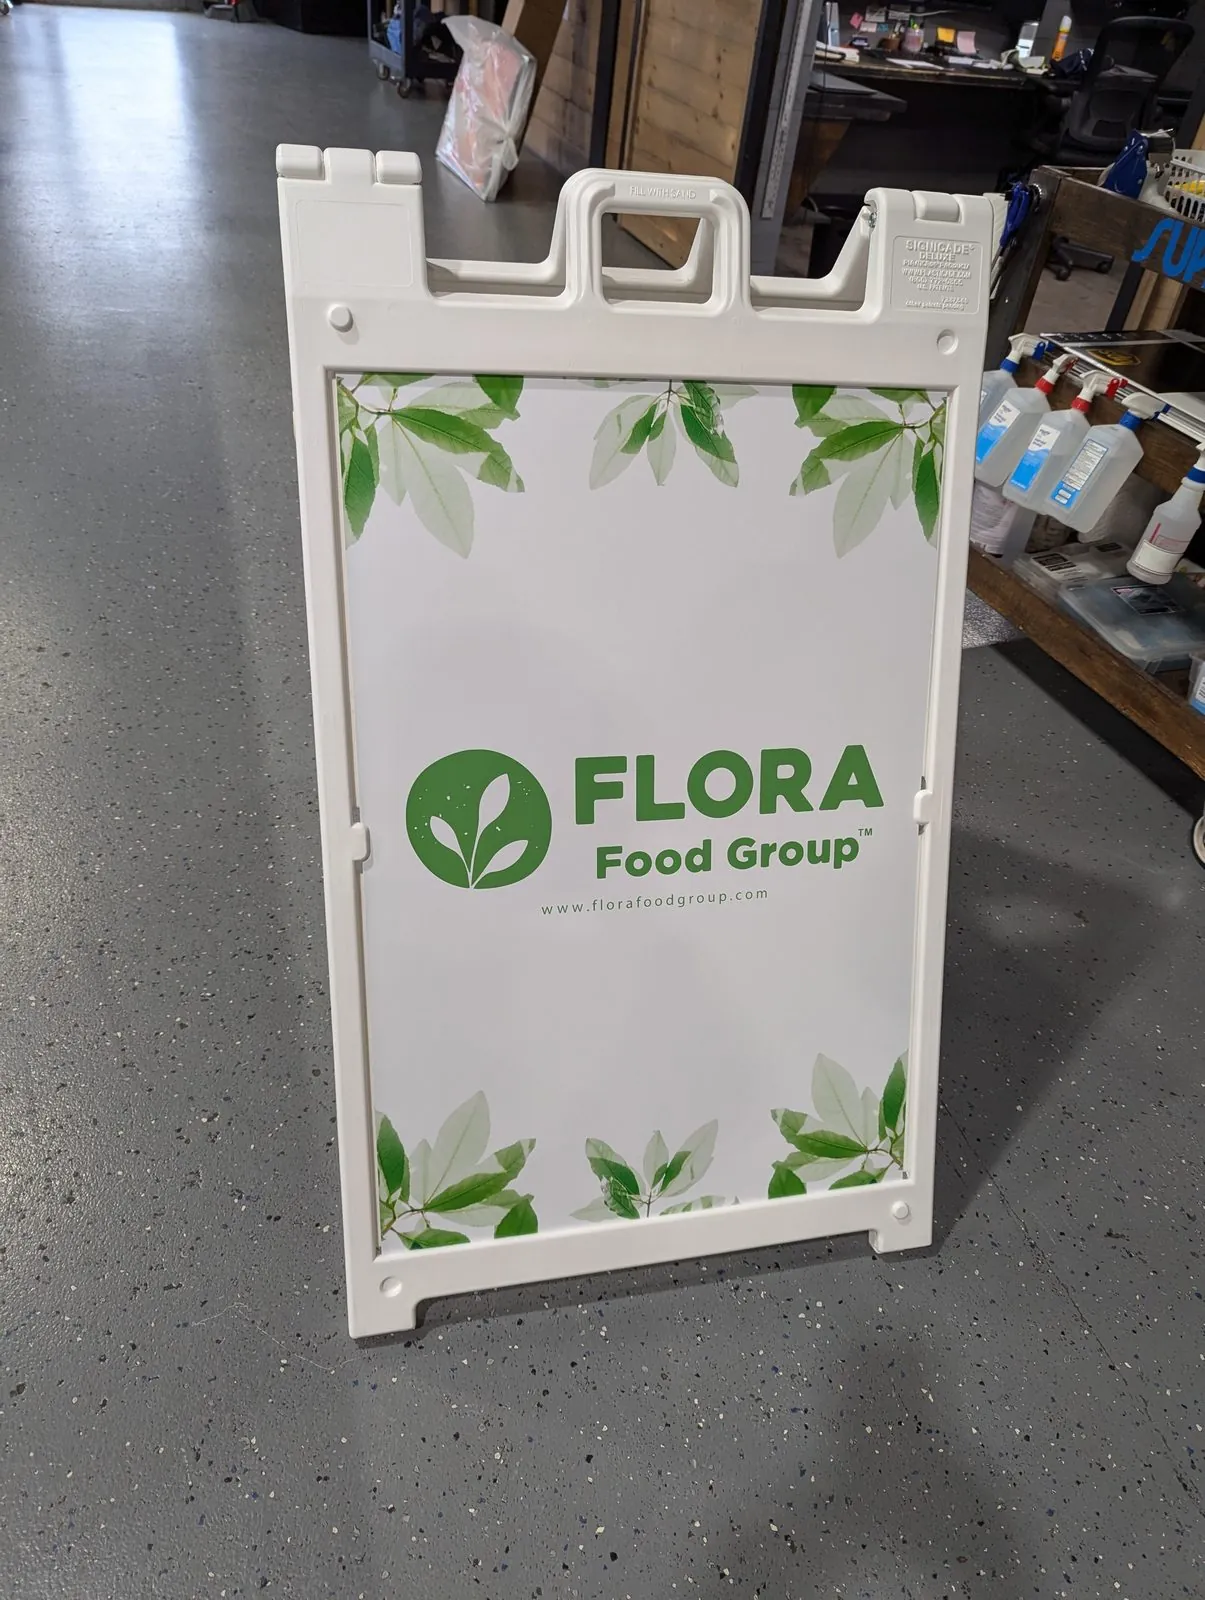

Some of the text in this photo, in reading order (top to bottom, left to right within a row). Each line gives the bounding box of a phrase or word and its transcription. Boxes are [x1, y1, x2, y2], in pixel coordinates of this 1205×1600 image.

[631, 186, 697, 200] FILL WITH SAND
[920, 251, 956, 262] DELUXE
[575, 744, 884, 825] FLORA
[596, 838, 712, 879] Food
[541, 889, 768, 915] www.florafoodgroup.com
